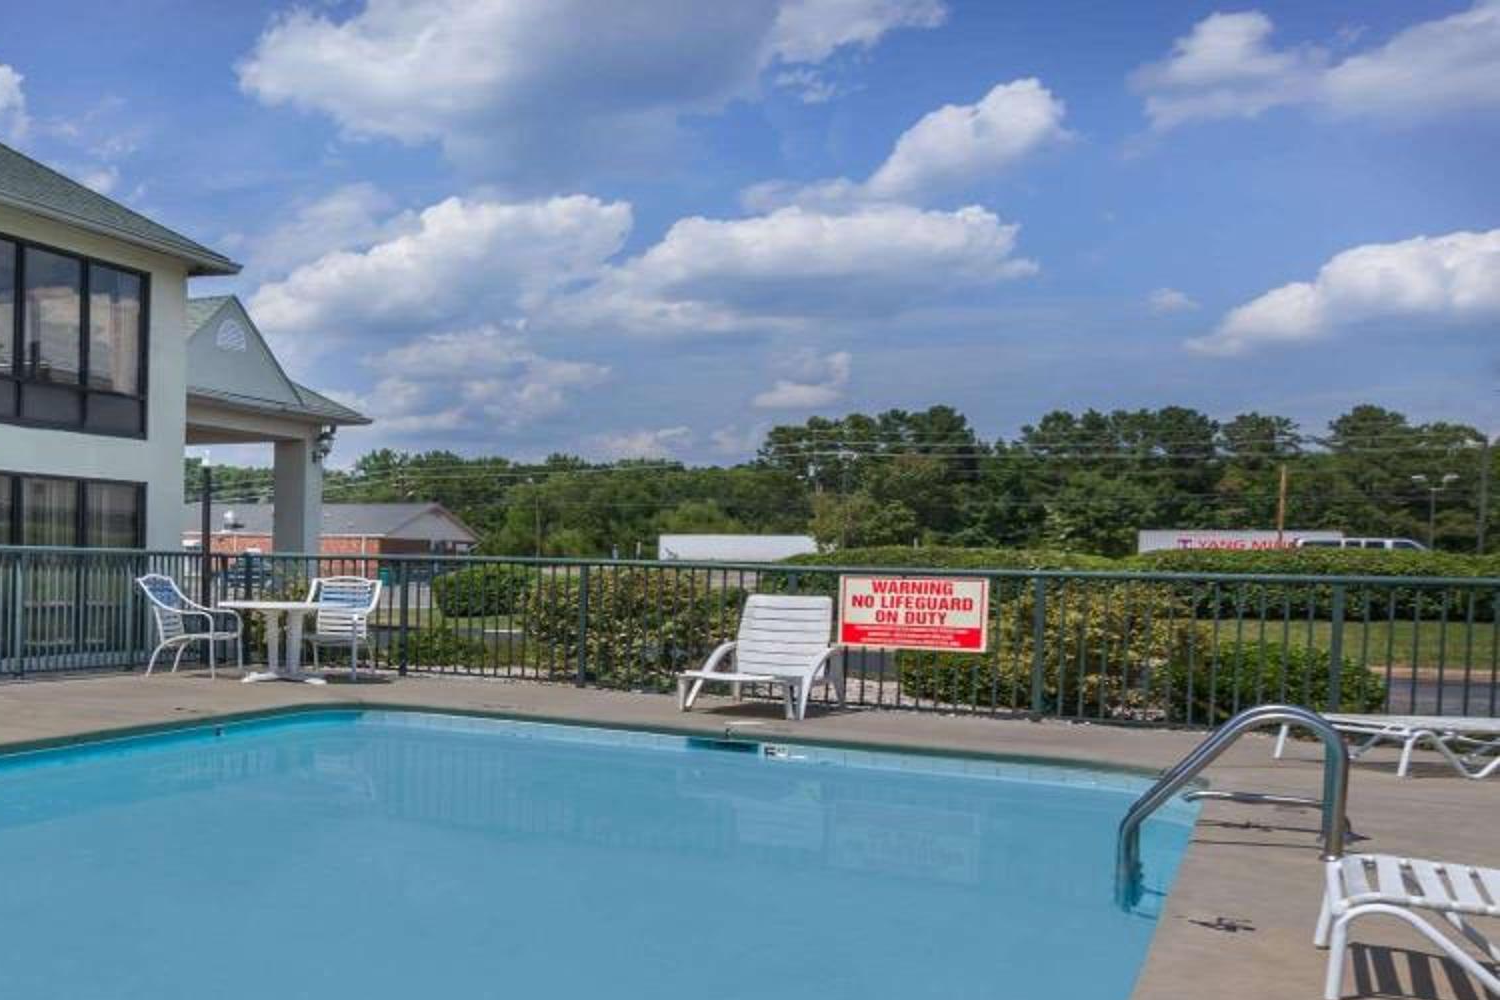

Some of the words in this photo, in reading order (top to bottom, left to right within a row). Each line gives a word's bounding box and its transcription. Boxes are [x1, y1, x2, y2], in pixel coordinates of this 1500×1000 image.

[871, 581, 954, 595] WARNING
[852, 595, 875, 608] NO
[880, 596, 973, 611] LIFEGUARD
[875, 609, 898, 622] ON
[905, 611, 947, 625] DUTY
